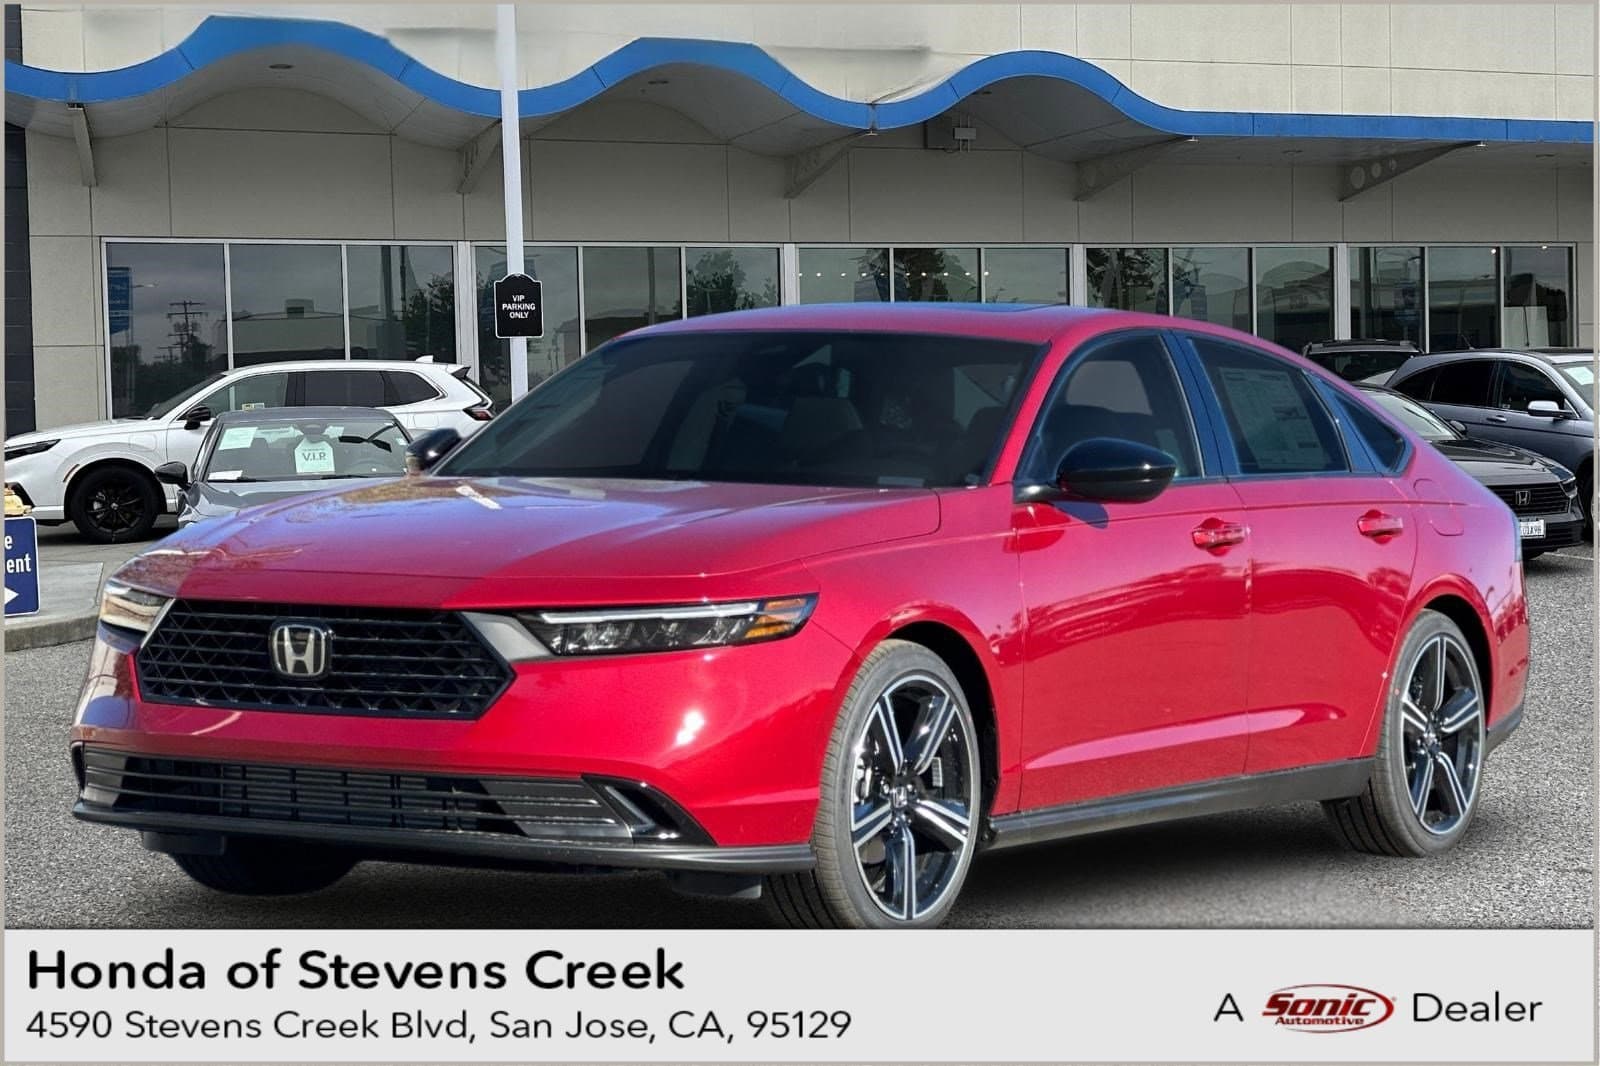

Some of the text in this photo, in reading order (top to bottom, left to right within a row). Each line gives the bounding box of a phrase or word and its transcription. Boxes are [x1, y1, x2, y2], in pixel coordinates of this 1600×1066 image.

[502, 303, 536, 311] PARKING
[509, 311, 529, 319] ONLY
[6, 554, 31, 573] ent
